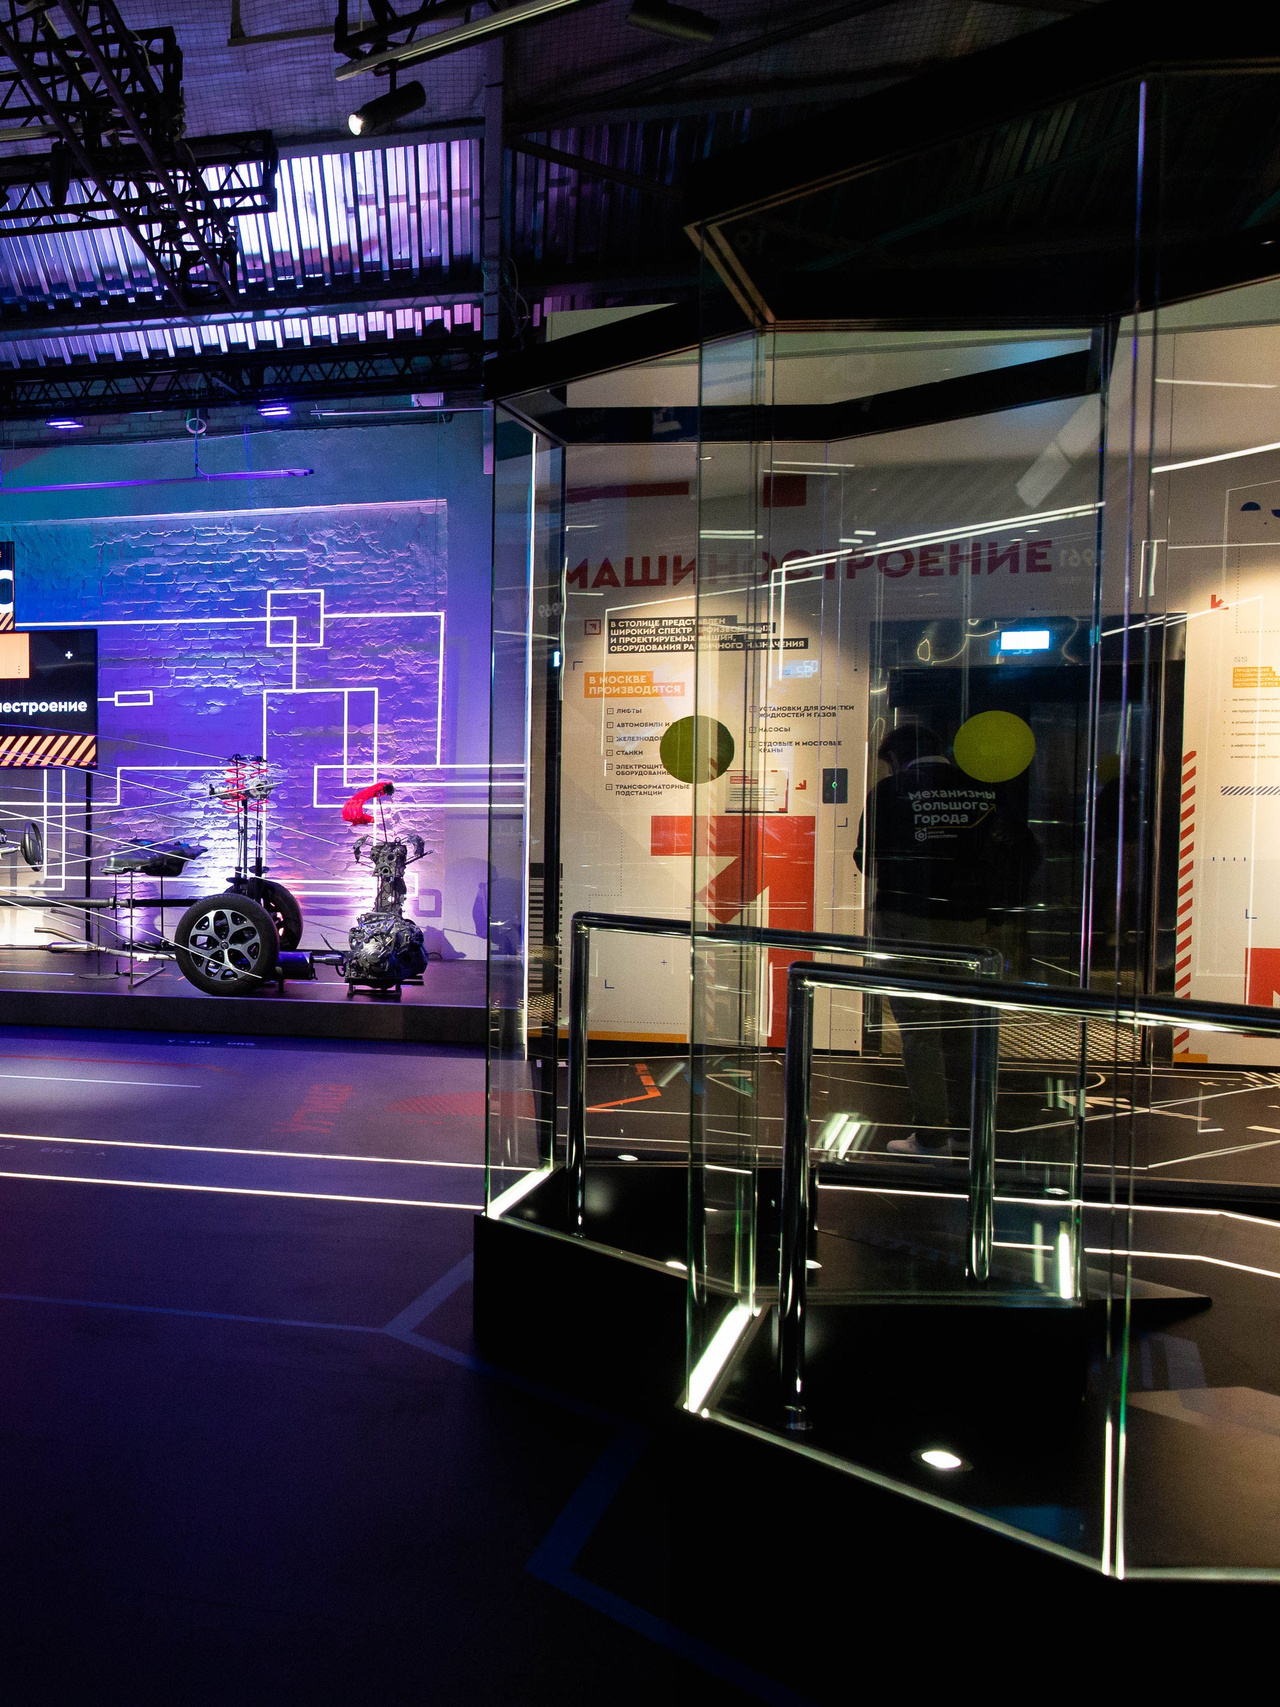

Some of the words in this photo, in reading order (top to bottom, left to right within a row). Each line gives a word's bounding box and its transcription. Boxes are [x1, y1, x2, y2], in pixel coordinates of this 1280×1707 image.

[618, 619, 660, 629] СТОЛИЦЕ
[662, 618, 726, 628] ПРЕДСТВЛЕН
[610, 626, 656, 636] ШИРОКИЙ
[657, 627, 693, 635] СПЕКТР
[618, 635, 696, 645] ПРОЕКТИРУЕМЫХ
[610, 643, 681, 653] ОБОРУДОВАНИЯ
[683, 641, 744, 651] РАЛИЧНОГО
[589, 676, 596, 684] В
[599, 675, 647, 684] МОСКВЕ
[589, 685, 681, 695] ПРОИЗВОДЯТСЯ
[907, 790, 996, 801] механизмы
[912, 800, 989, 812] большого
[914, 813, 969, 825] города
